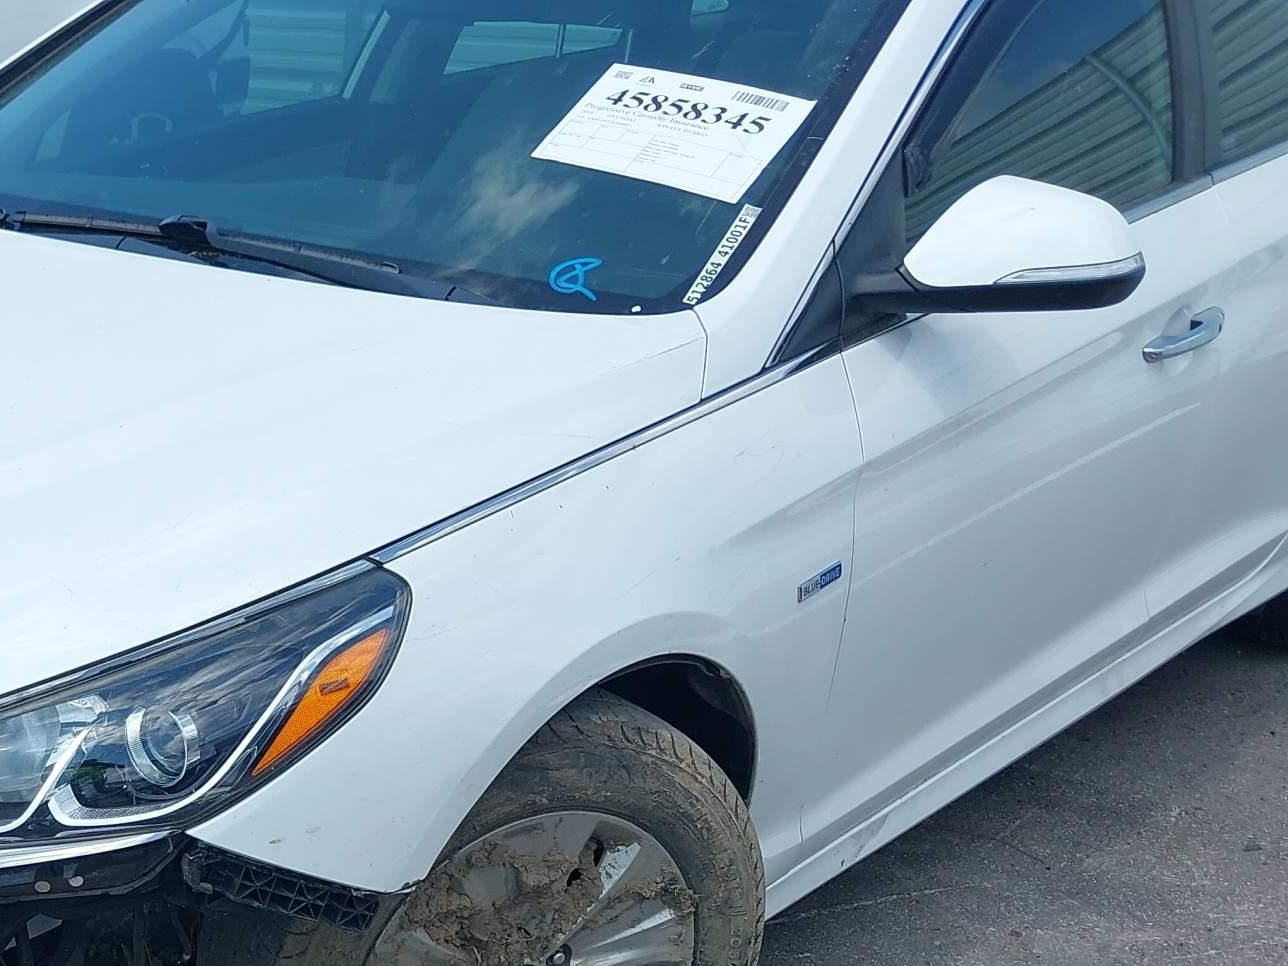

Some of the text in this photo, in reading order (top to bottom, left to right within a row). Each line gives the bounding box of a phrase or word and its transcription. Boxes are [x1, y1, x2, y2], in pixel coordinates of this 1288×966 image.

[605, 88, 773, 134] 45858345
[686, 216, 751, 303] 512864 41001F
